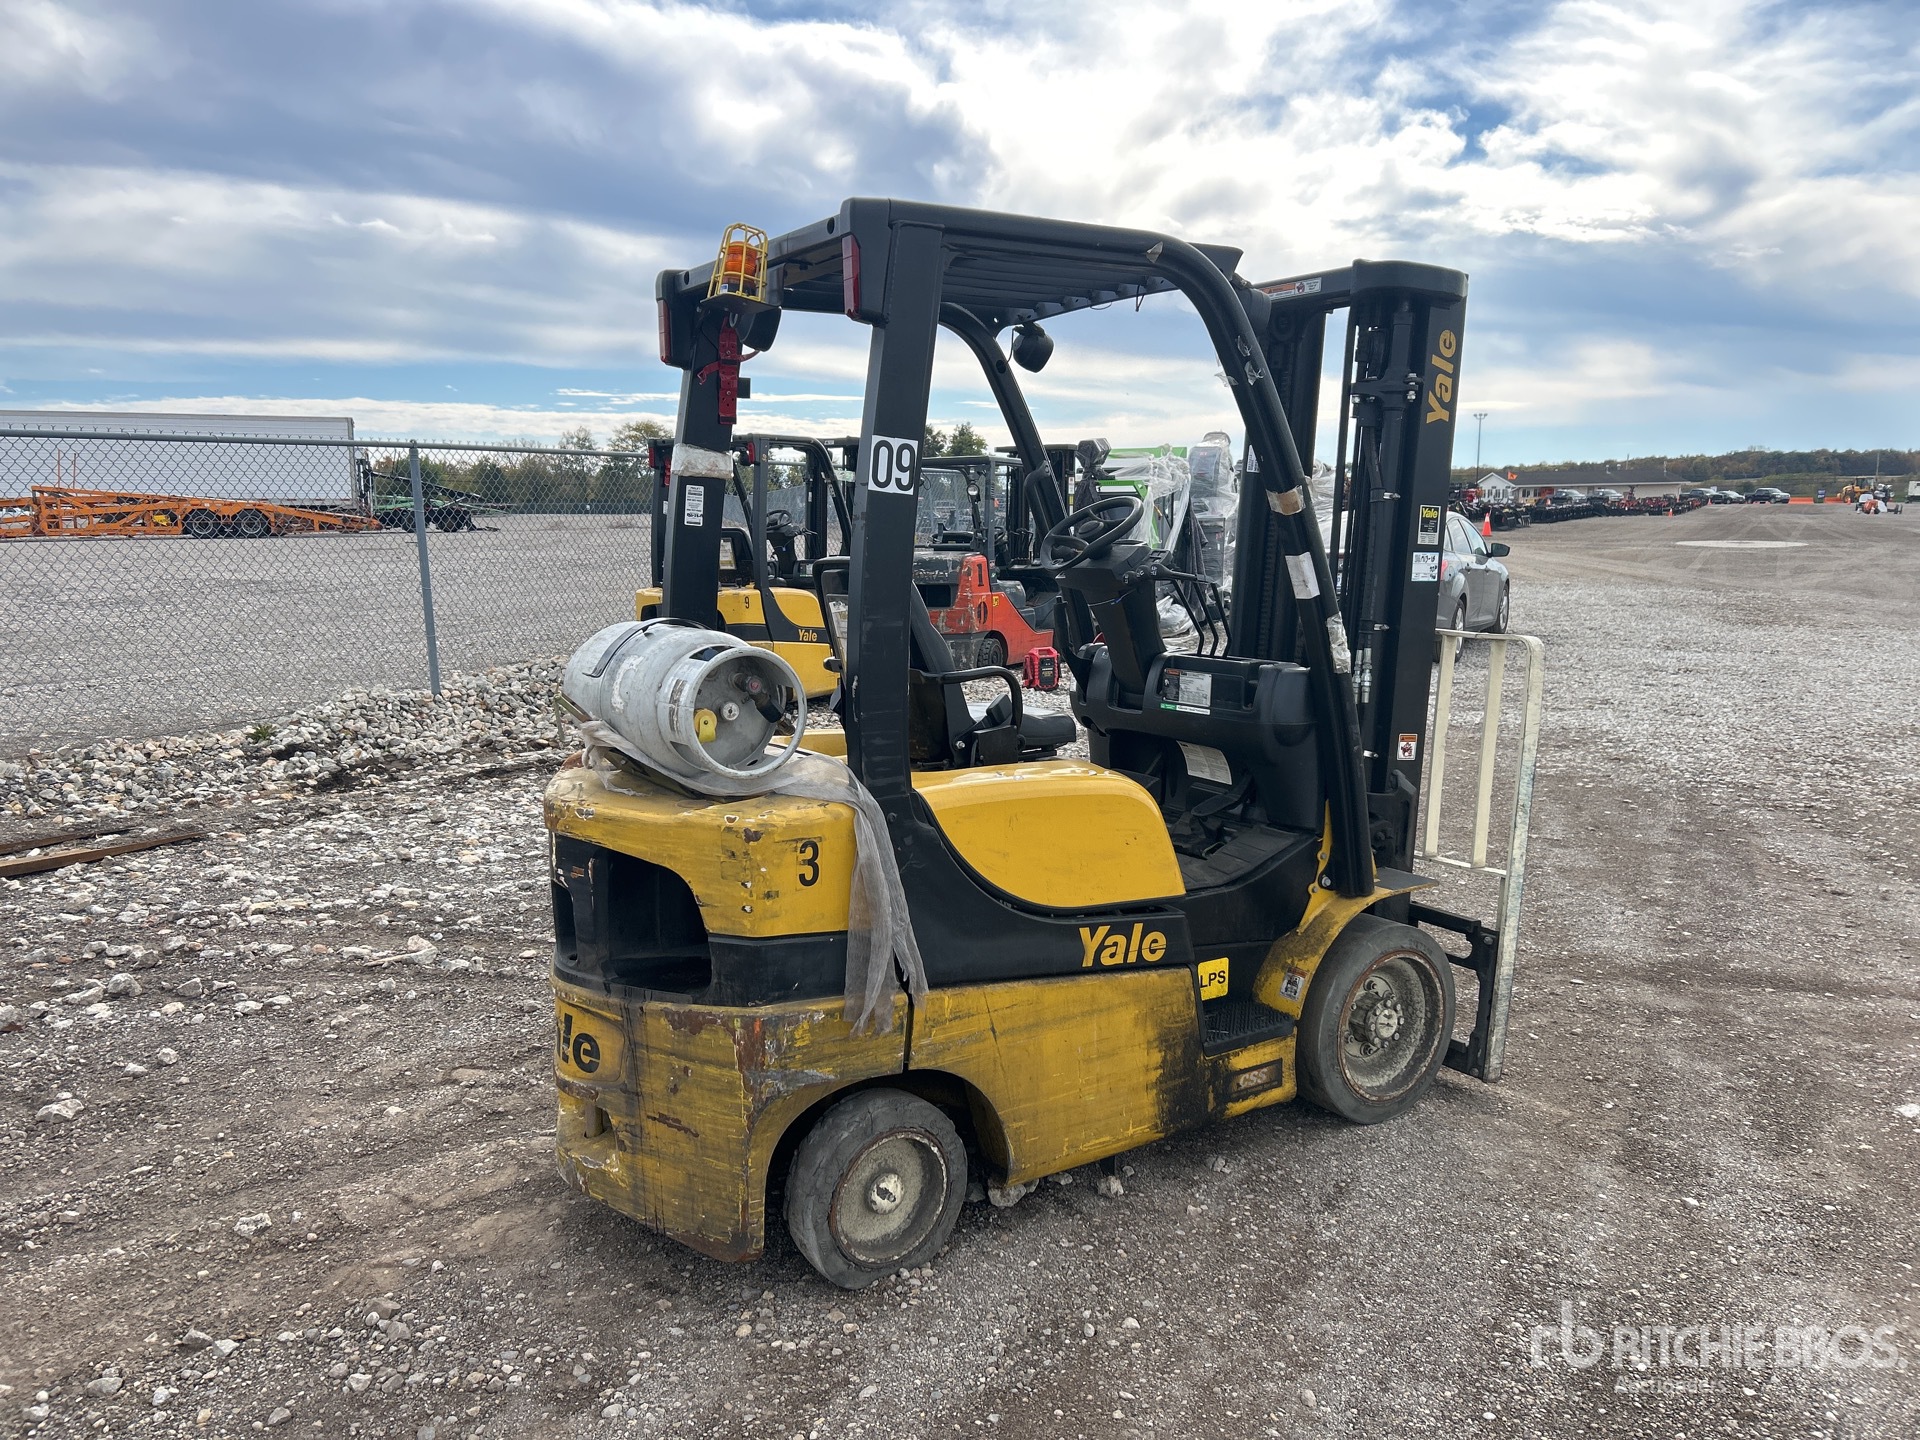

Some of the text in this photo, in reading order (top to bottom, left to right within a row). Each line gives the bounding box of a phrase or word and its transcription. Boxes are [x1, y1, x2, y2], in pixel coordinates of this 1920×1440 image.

[1426, 329, 1457, 424] Yale
[871, 440, 916, 491] 09
[1422, 507, 1439, 519] Yale
[744, 596, 750, 609] 9
[798, 628, 818, 642] Yale
[799, 840, 819, 887] 3
[1079, 922, 1167, 968] Yale
[1200, 970, 1226, 989] LPS
[557, 1012, 601, 1074] le
